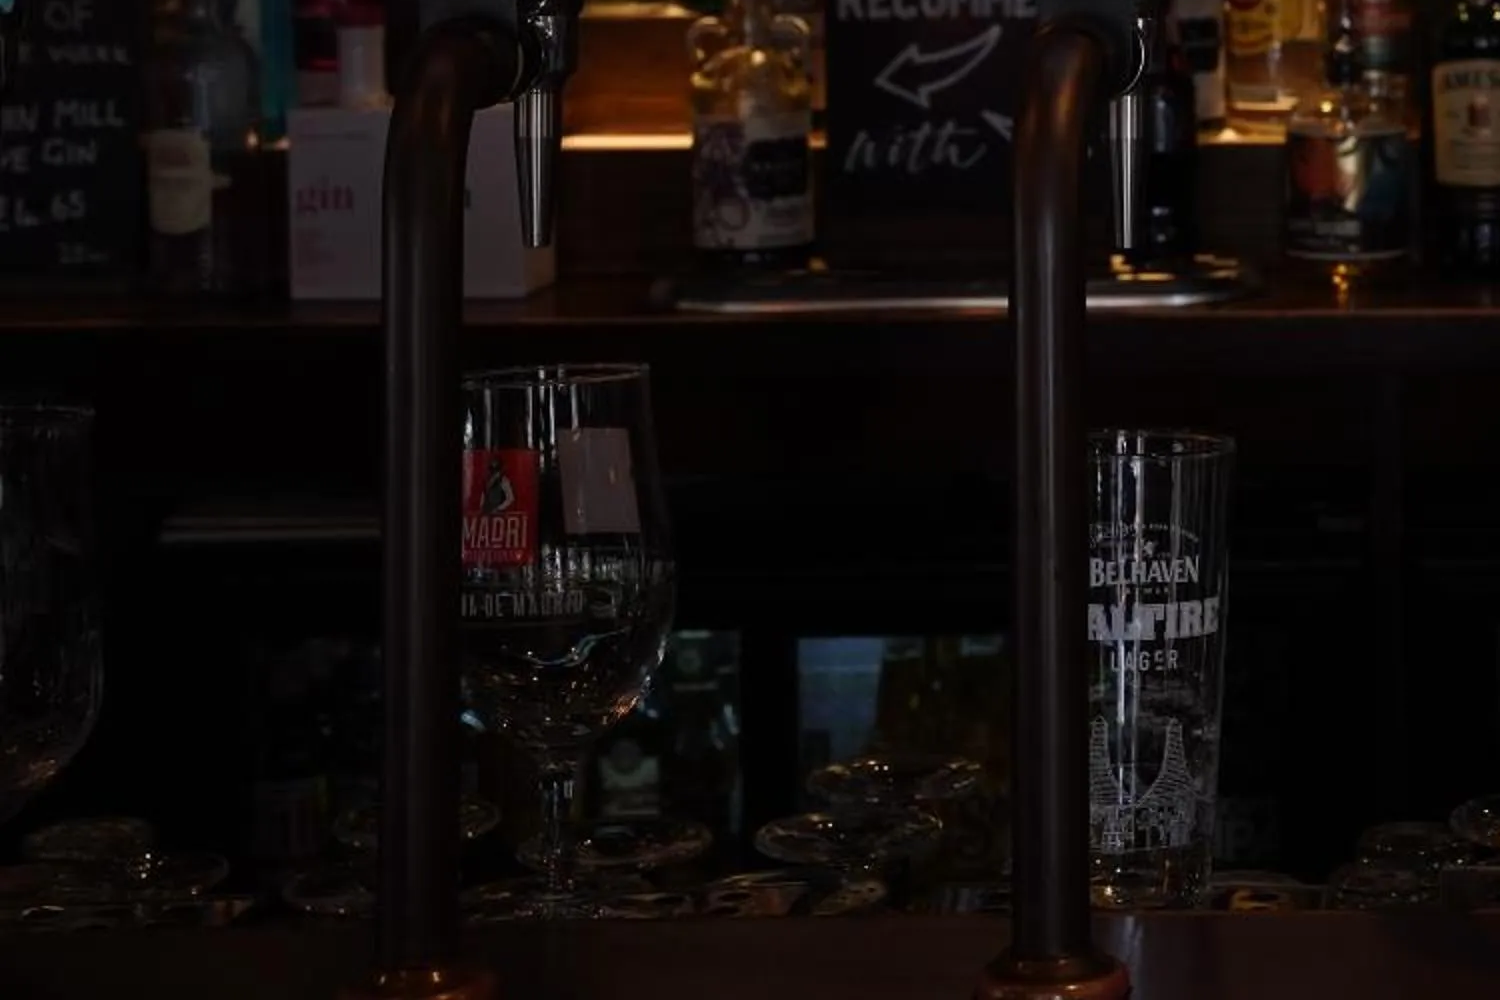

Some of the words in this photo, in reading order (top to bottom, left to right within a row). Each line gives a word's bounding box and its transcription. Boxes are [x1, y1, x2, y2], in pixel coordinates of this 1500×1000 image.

[41, 137, 98, 167] GIN
[1089, 555, 1200, 588] BELHAVEN
[1087, 596, 1221, 642] ALTIRE
[1110, 649, 1179, 673] LAGER
